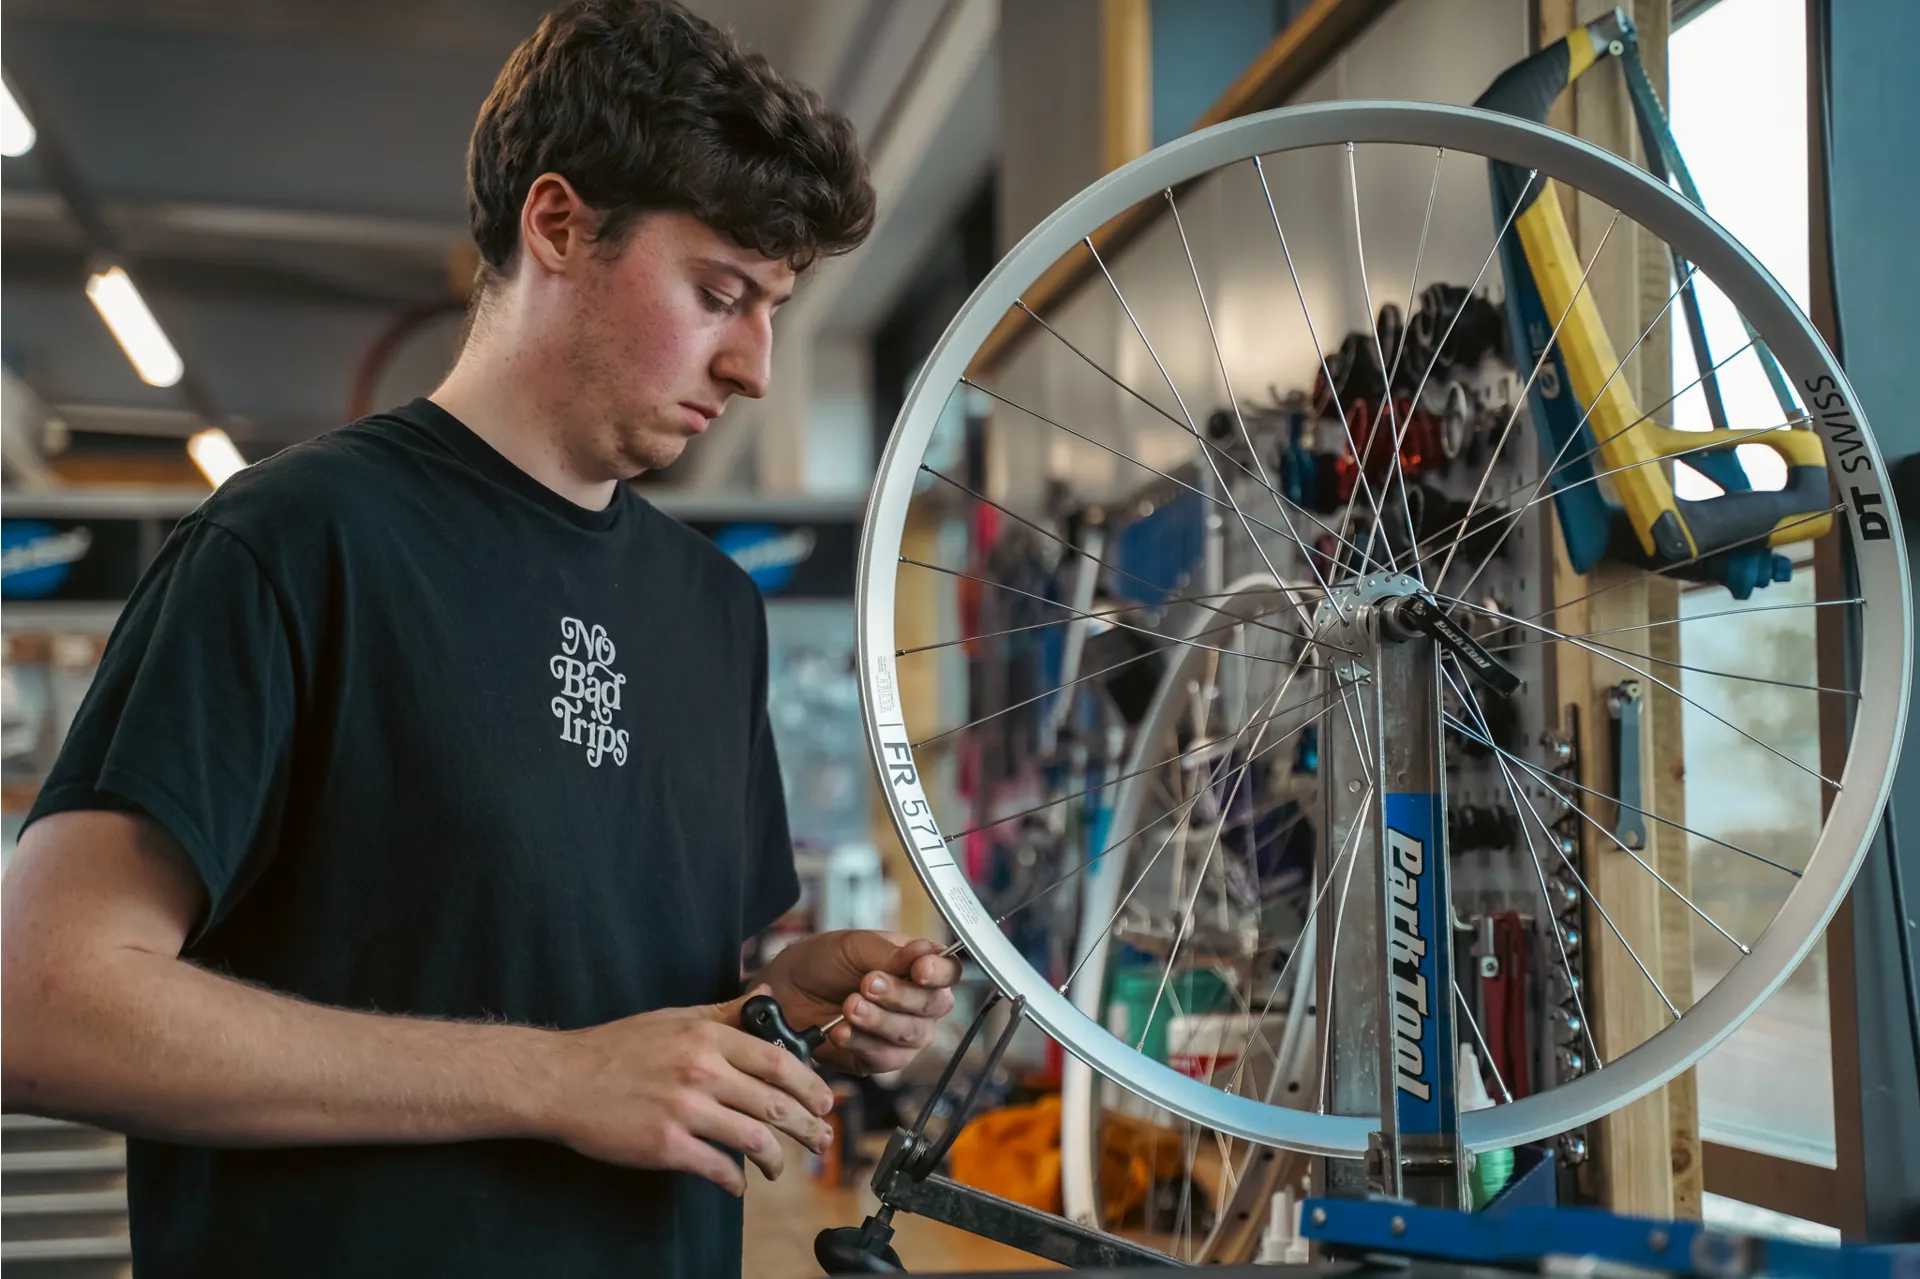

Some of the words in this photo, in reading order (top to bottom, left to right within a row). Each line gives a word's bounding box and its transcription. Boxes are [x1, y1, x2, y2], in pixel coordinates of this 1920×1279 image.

[1805, 375, 1872, 473] SWISS
[1850, 486, 1891, 540] DT
[560, 616, 616, 666] No
[550, 655, 627, 725] Bad
[551, 696, 629, 768] Trips
[883, 742, 917, 787] FR
[902, 799, 945, 851] 571
